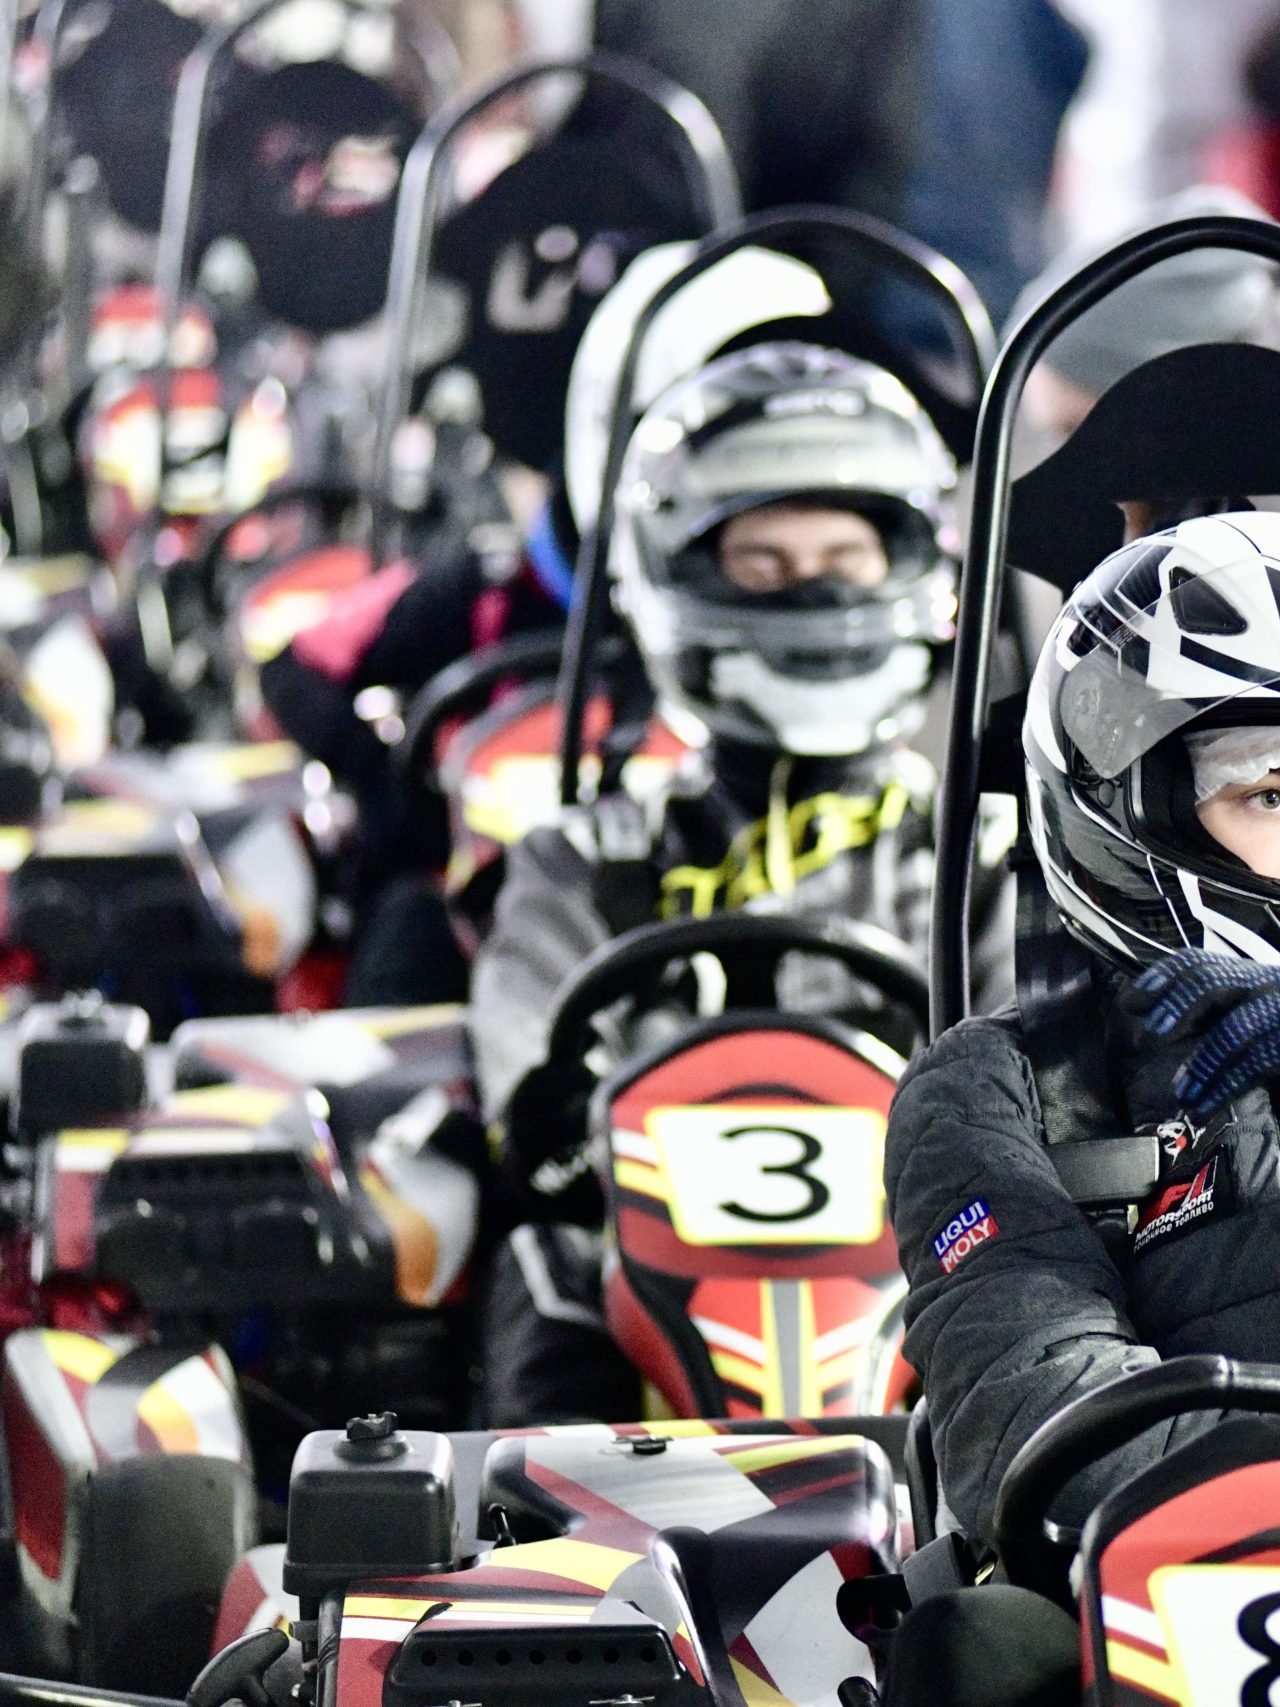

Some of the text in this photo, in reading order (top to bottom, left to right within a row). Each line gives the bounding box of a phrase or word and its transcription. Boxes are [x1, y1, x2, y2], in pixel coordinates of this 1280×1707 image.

[719, 1125, 830, 1222] 3
[934, 1201, 986, 1257] LIQUI
[1134, 1189, 1214, 1243] MOTORSPORT
[941, 1217, 992, 1274] MOLY
